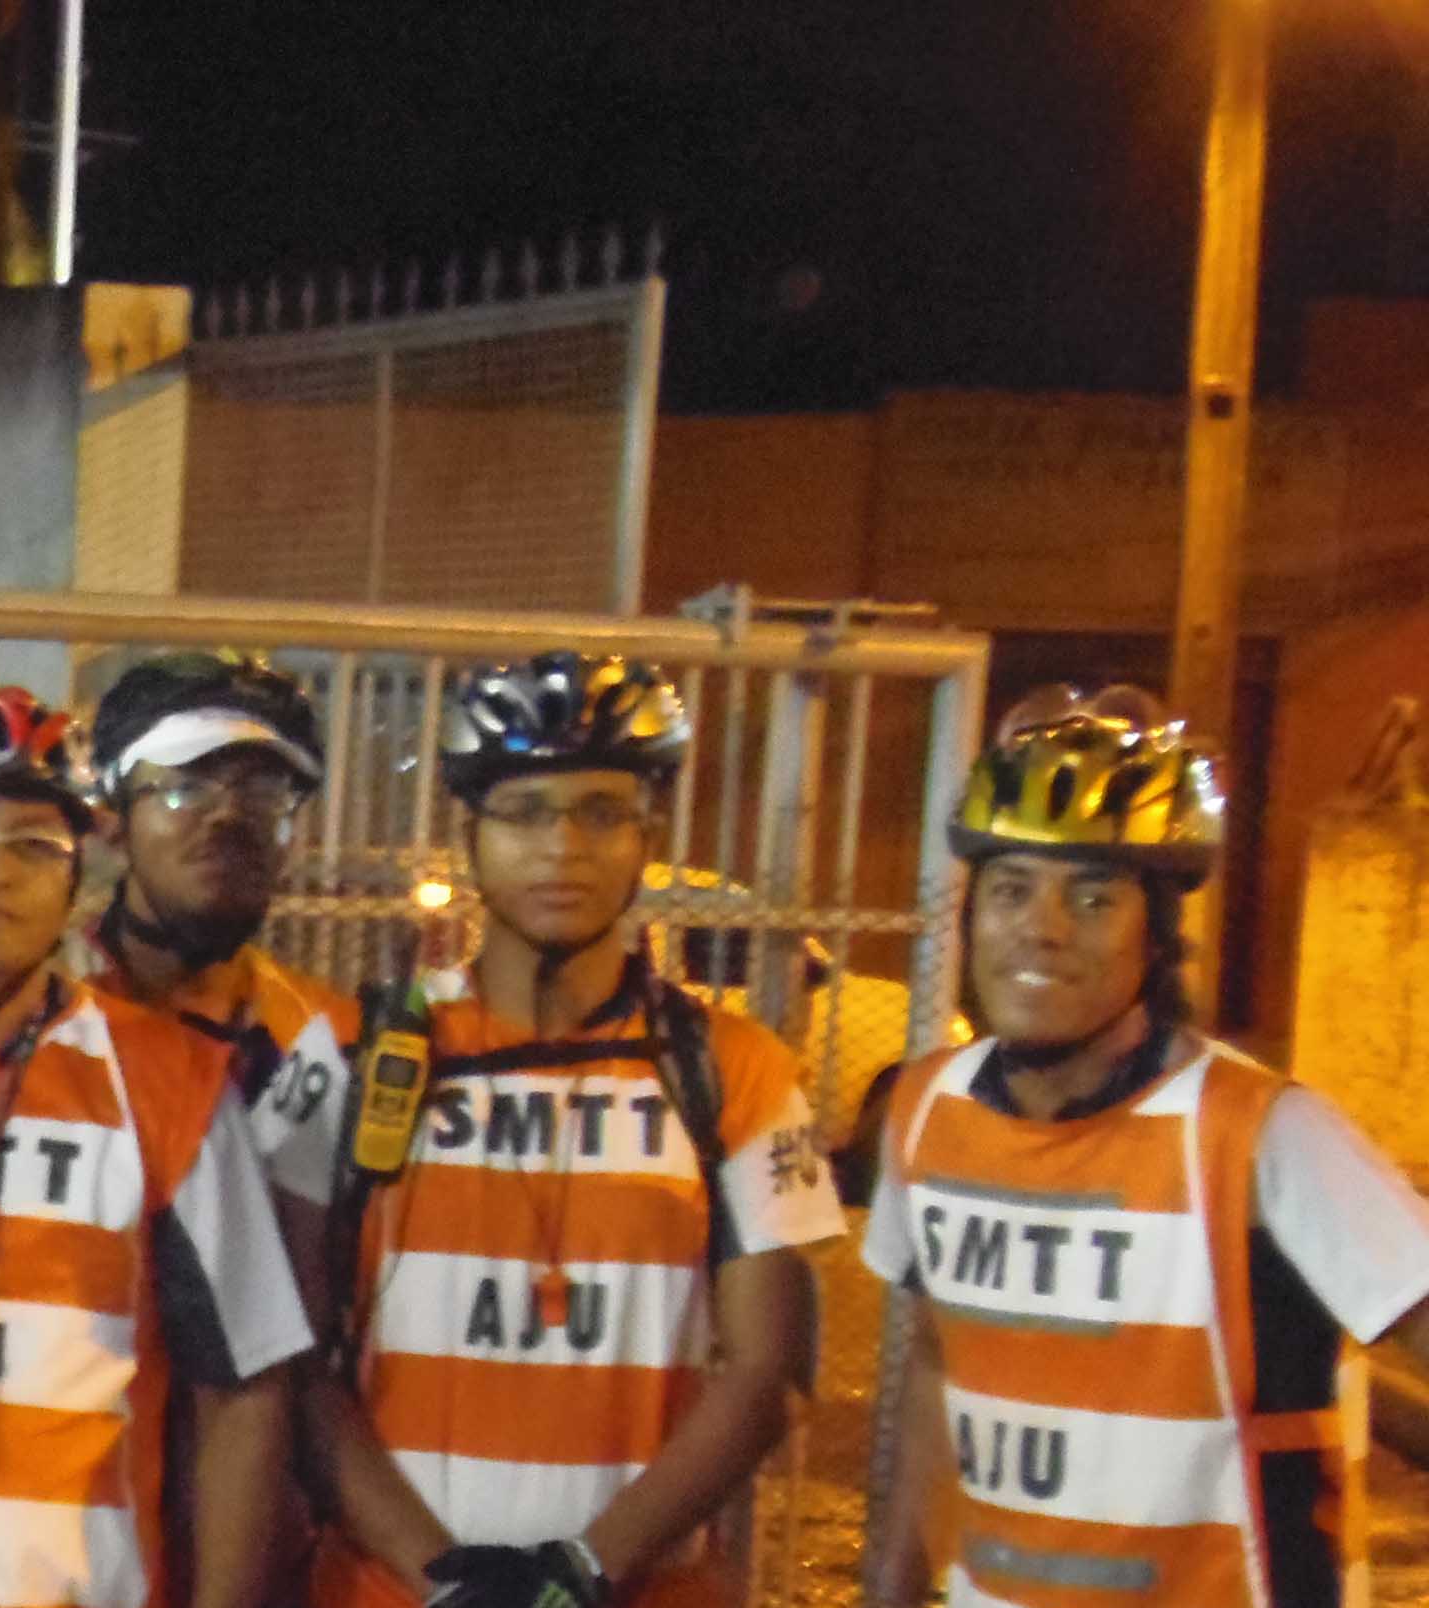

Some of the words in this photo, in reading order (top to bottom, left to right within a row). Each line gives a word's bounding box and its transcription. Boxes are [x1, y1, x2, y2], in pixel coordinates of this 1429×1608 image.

[423, 1087, 667, 1158] SMTT
[923, 1205, 1133, 1303] SMTT
[465, 1277, 609, 1353] AJU
